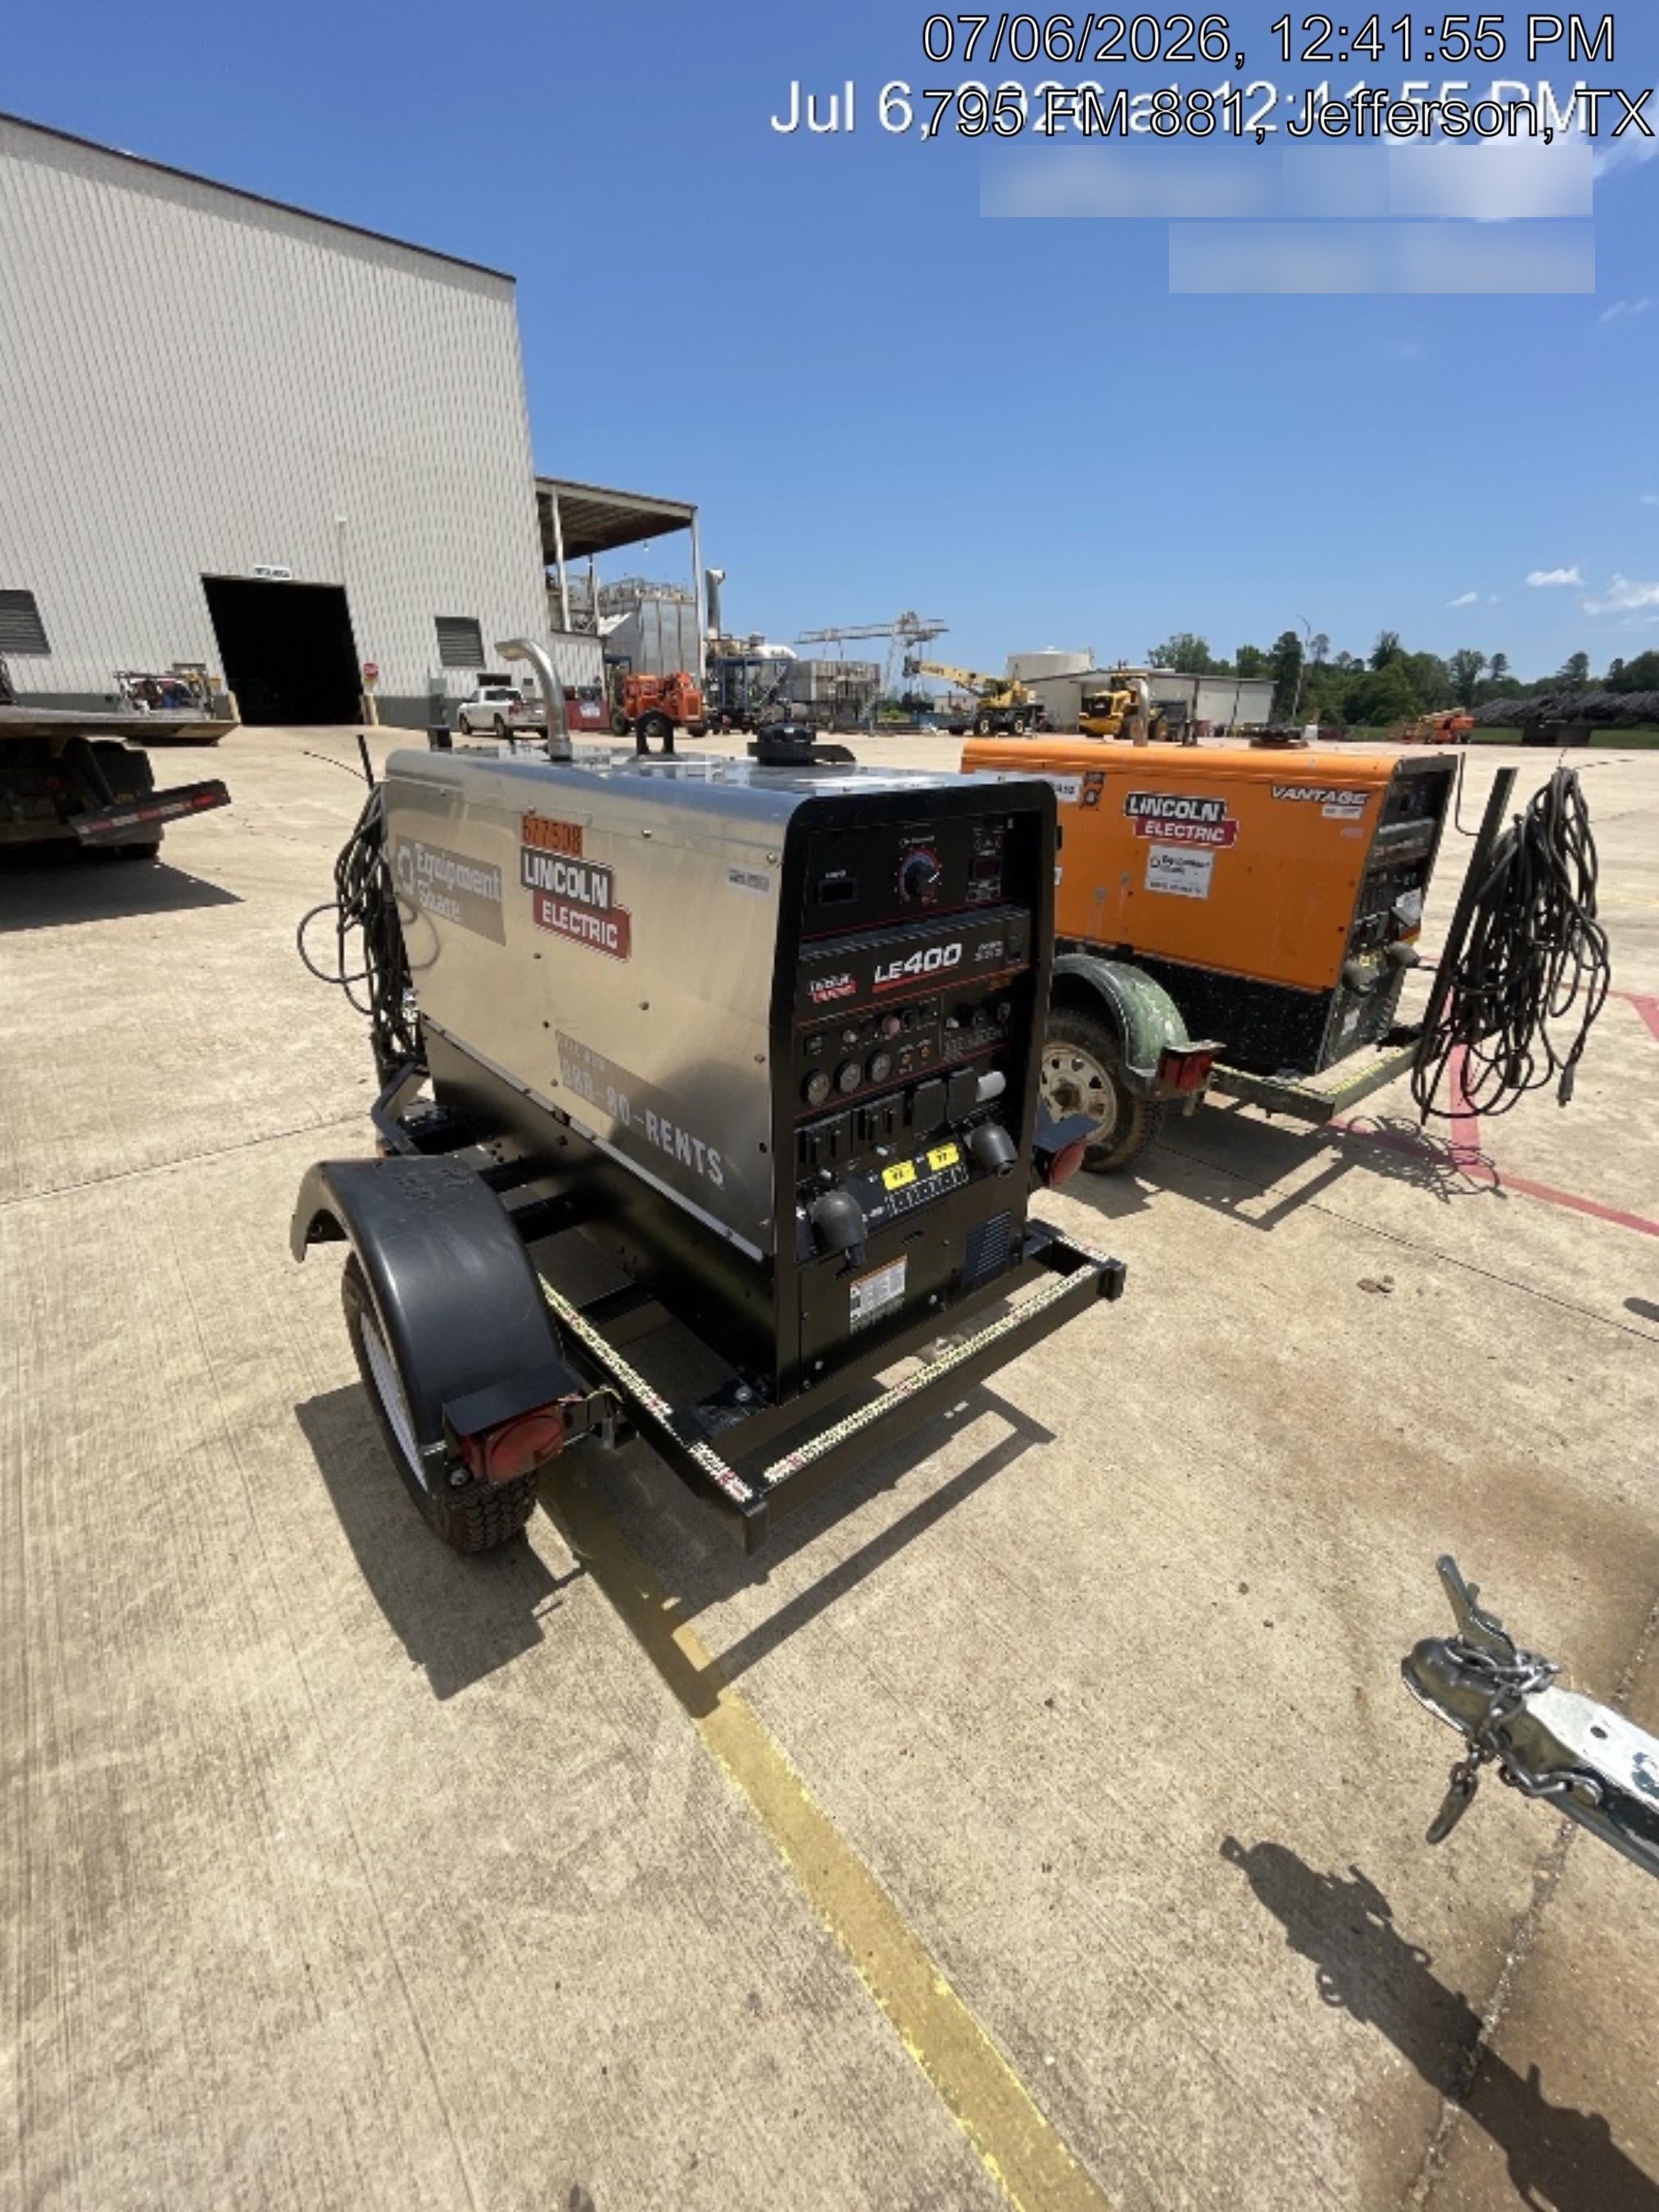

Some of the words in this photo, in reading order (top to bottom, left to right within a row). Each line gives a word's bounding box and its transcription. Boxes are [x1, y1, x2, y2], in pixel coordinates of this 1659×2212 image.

[1129, 796, 1219, 821] LINCOLN
[1272, 786, 1371, 805] VANTAGE
[1145, 820, 1225, 841] ELECTRIC
[415, 842, 500, 903] Equipment
[524, 851, 609, 911] LINCOLN
[542, 899, 619, 949] ELECTRIC
[874, 943, 963, 983] LE400
